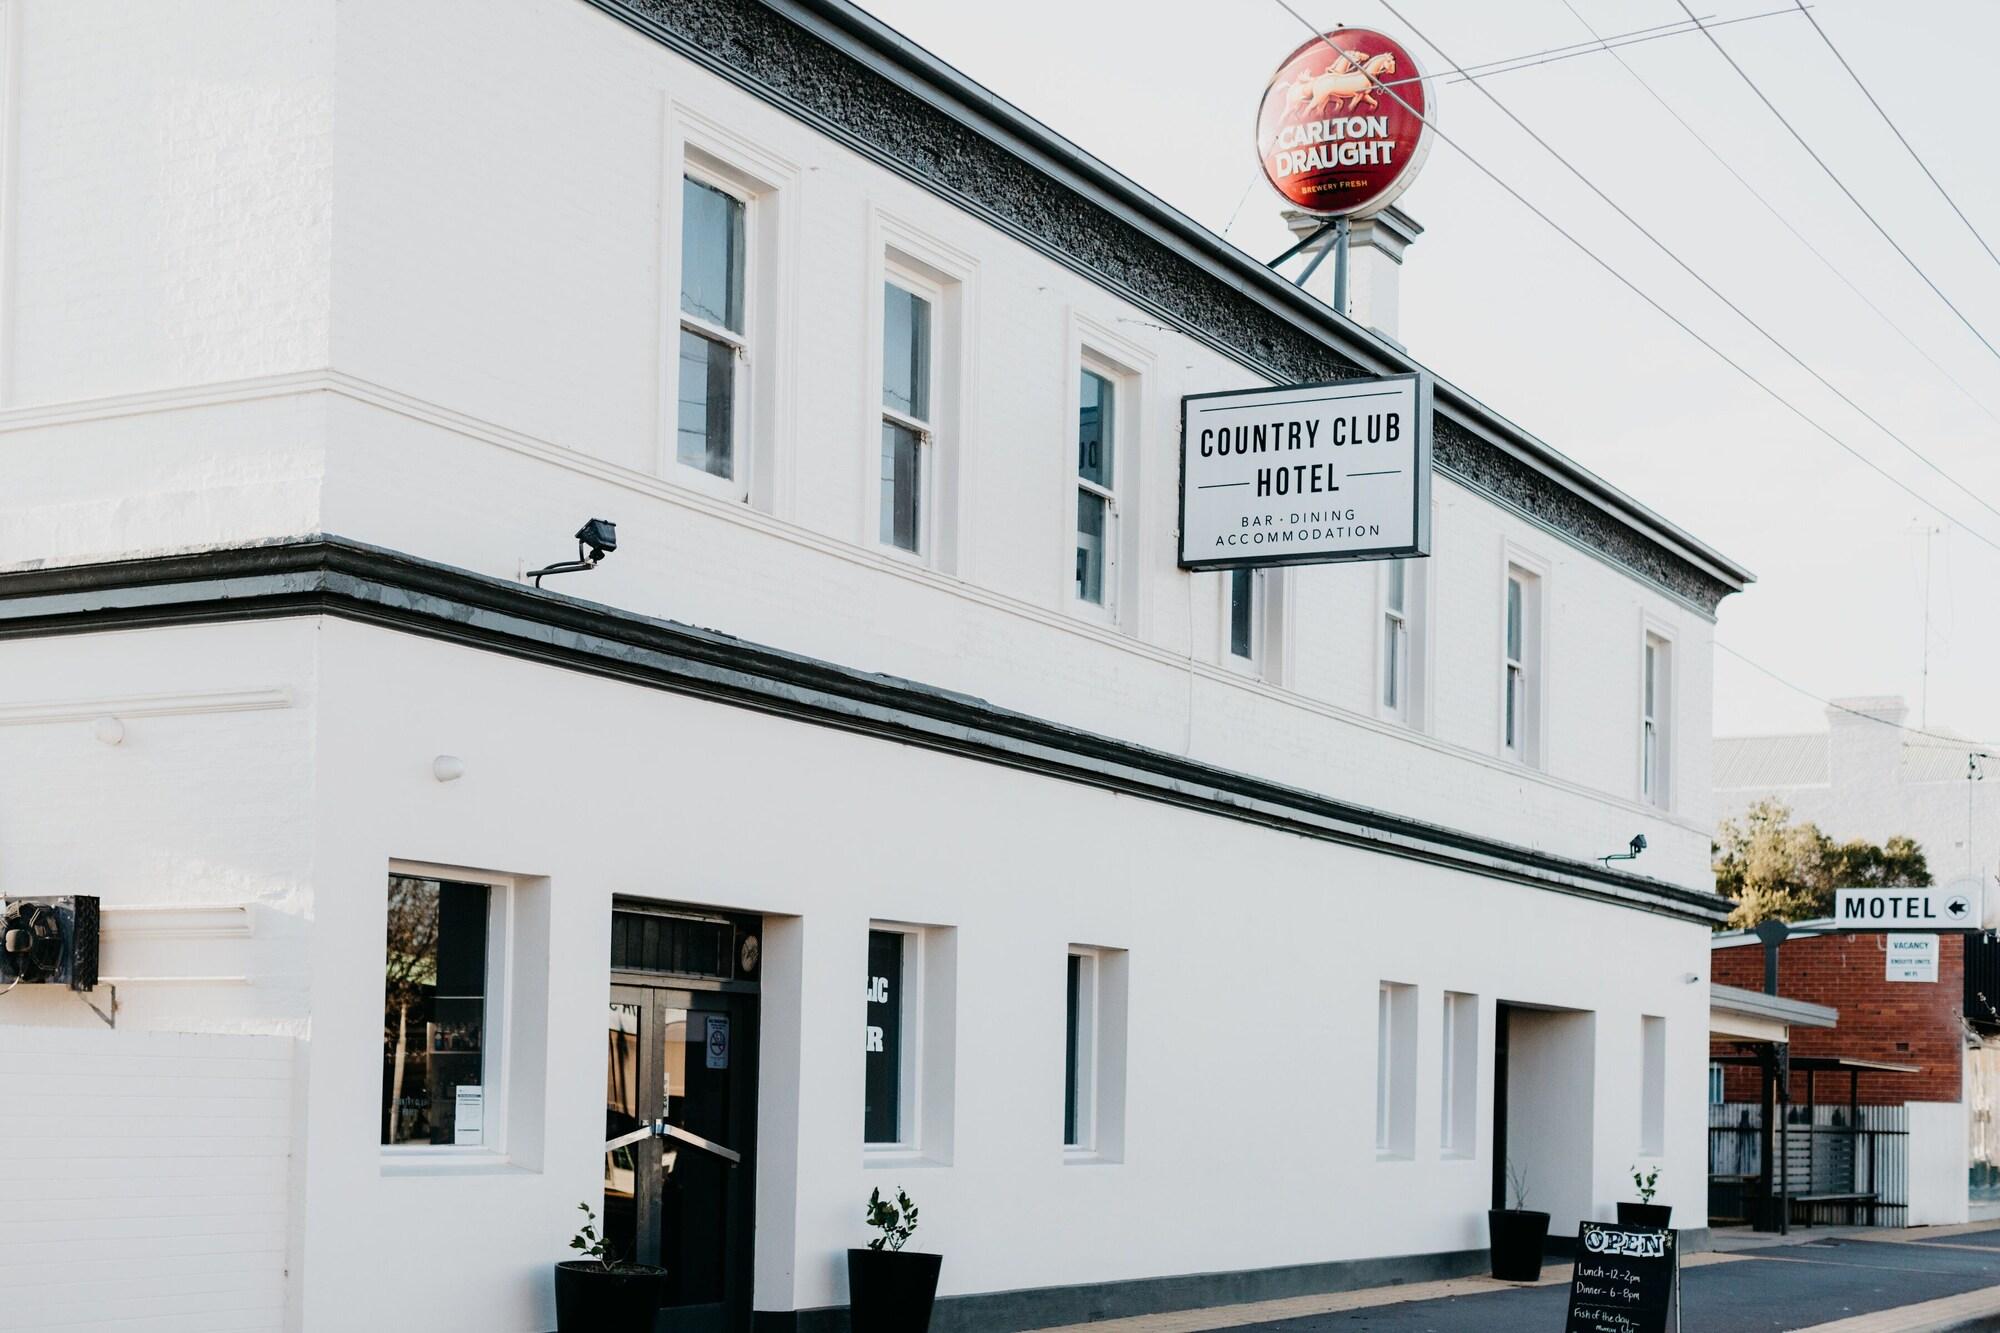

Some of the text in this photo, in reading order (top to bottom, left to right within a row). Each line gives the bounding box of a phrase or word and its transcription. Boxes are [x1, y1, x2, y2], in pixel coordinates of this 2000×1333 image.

[1277, 116, 1390, 149] CARLTON
[1275, 141, 1395, 178] DRAUGHT
[1302, 180, 1368, 195] BREWERY FRESH
[1200, 412, 1401, 458] COUNTRY CLUB
[1257, 463, 1340, 497] HOTEL
[1241, 509, 1356, 528] BAR DINING
[1215, 524, 1380, 547] ACCOMMODATION
[1845, 897, 1937, 919] MOTEL
[1893, 941, 1929, 950] VACANCY
[1585, 1230, 1665, 1258] OPEN
[1578, 1262, 1604, 1278] Lunch
[1574, 1307, 1591, 1319] Fish
[1591, 1309, 1601, 1320] of
[1602, 1311, 1614, 1323] the
